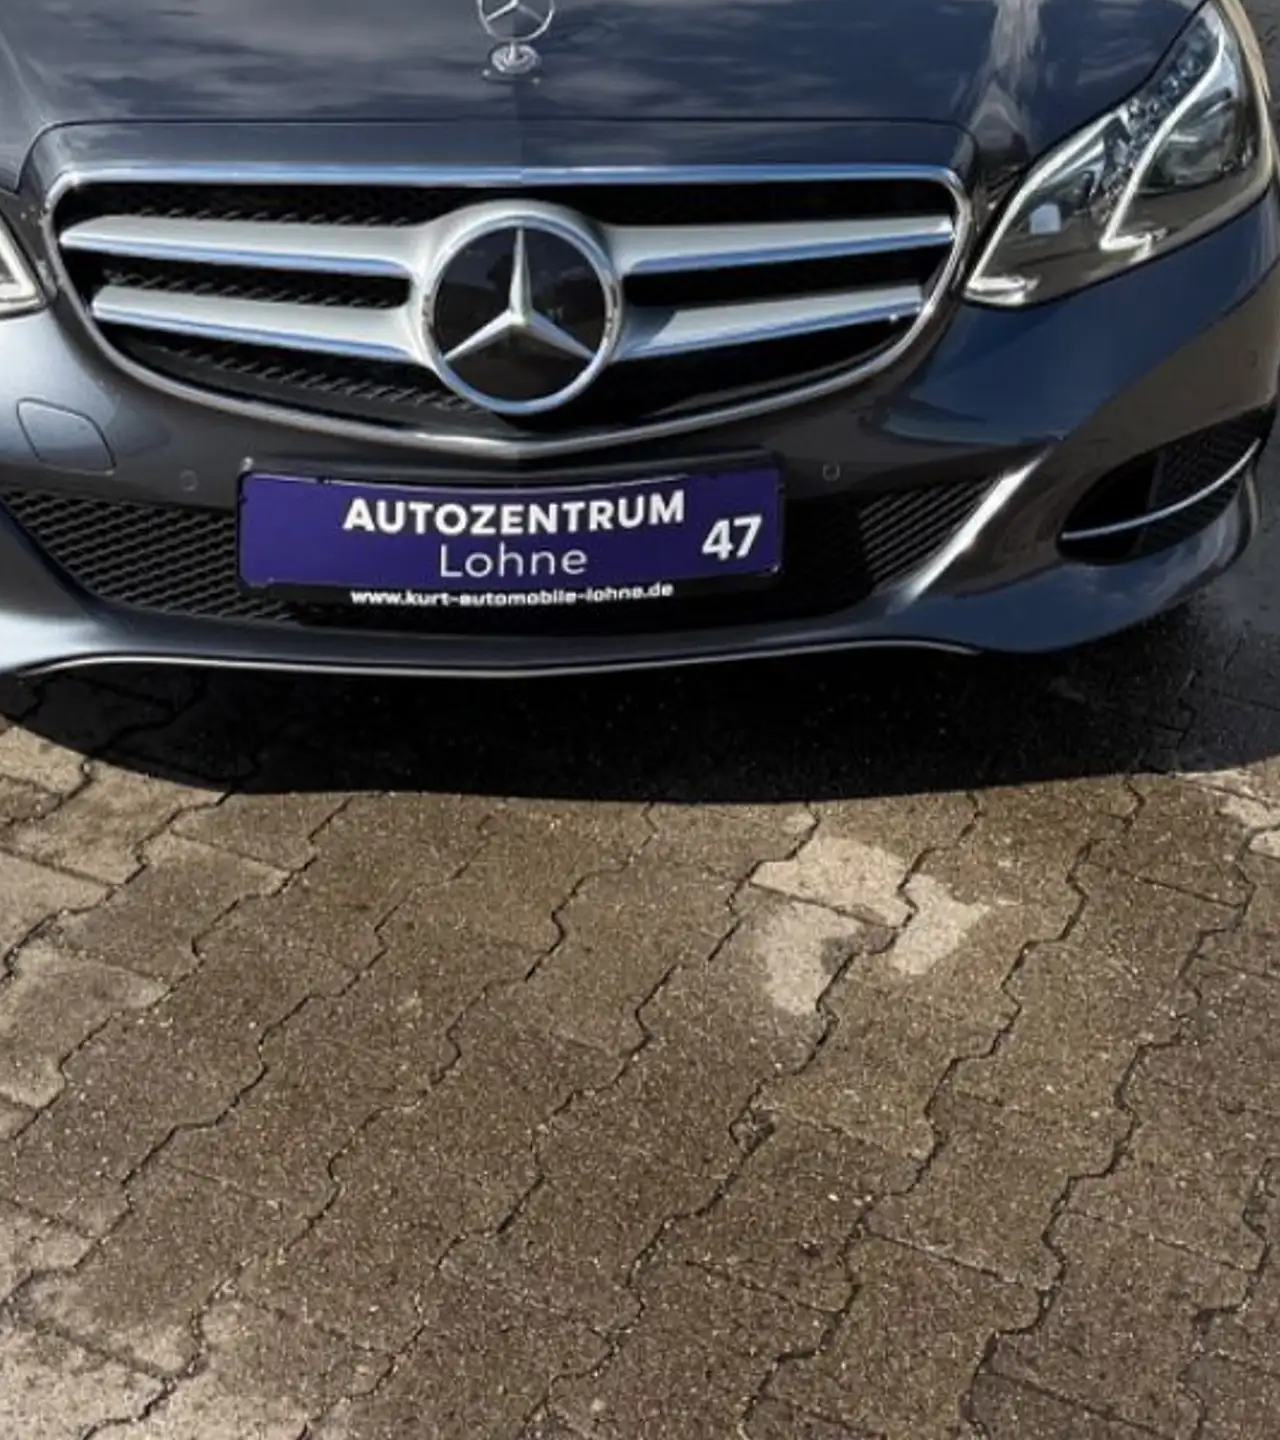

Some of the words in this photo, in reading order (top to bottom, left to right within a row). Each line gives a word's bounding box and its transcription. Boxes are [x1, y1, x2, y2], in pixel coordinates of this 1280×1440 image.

[342, 489, 686, 537] AUTOZENTRUM
[702, 516, 763, 561] 47
[439, 542, 589, 580] Lohne
[350, 580, 674, 607] www.kurt-automobile-lohne.de
